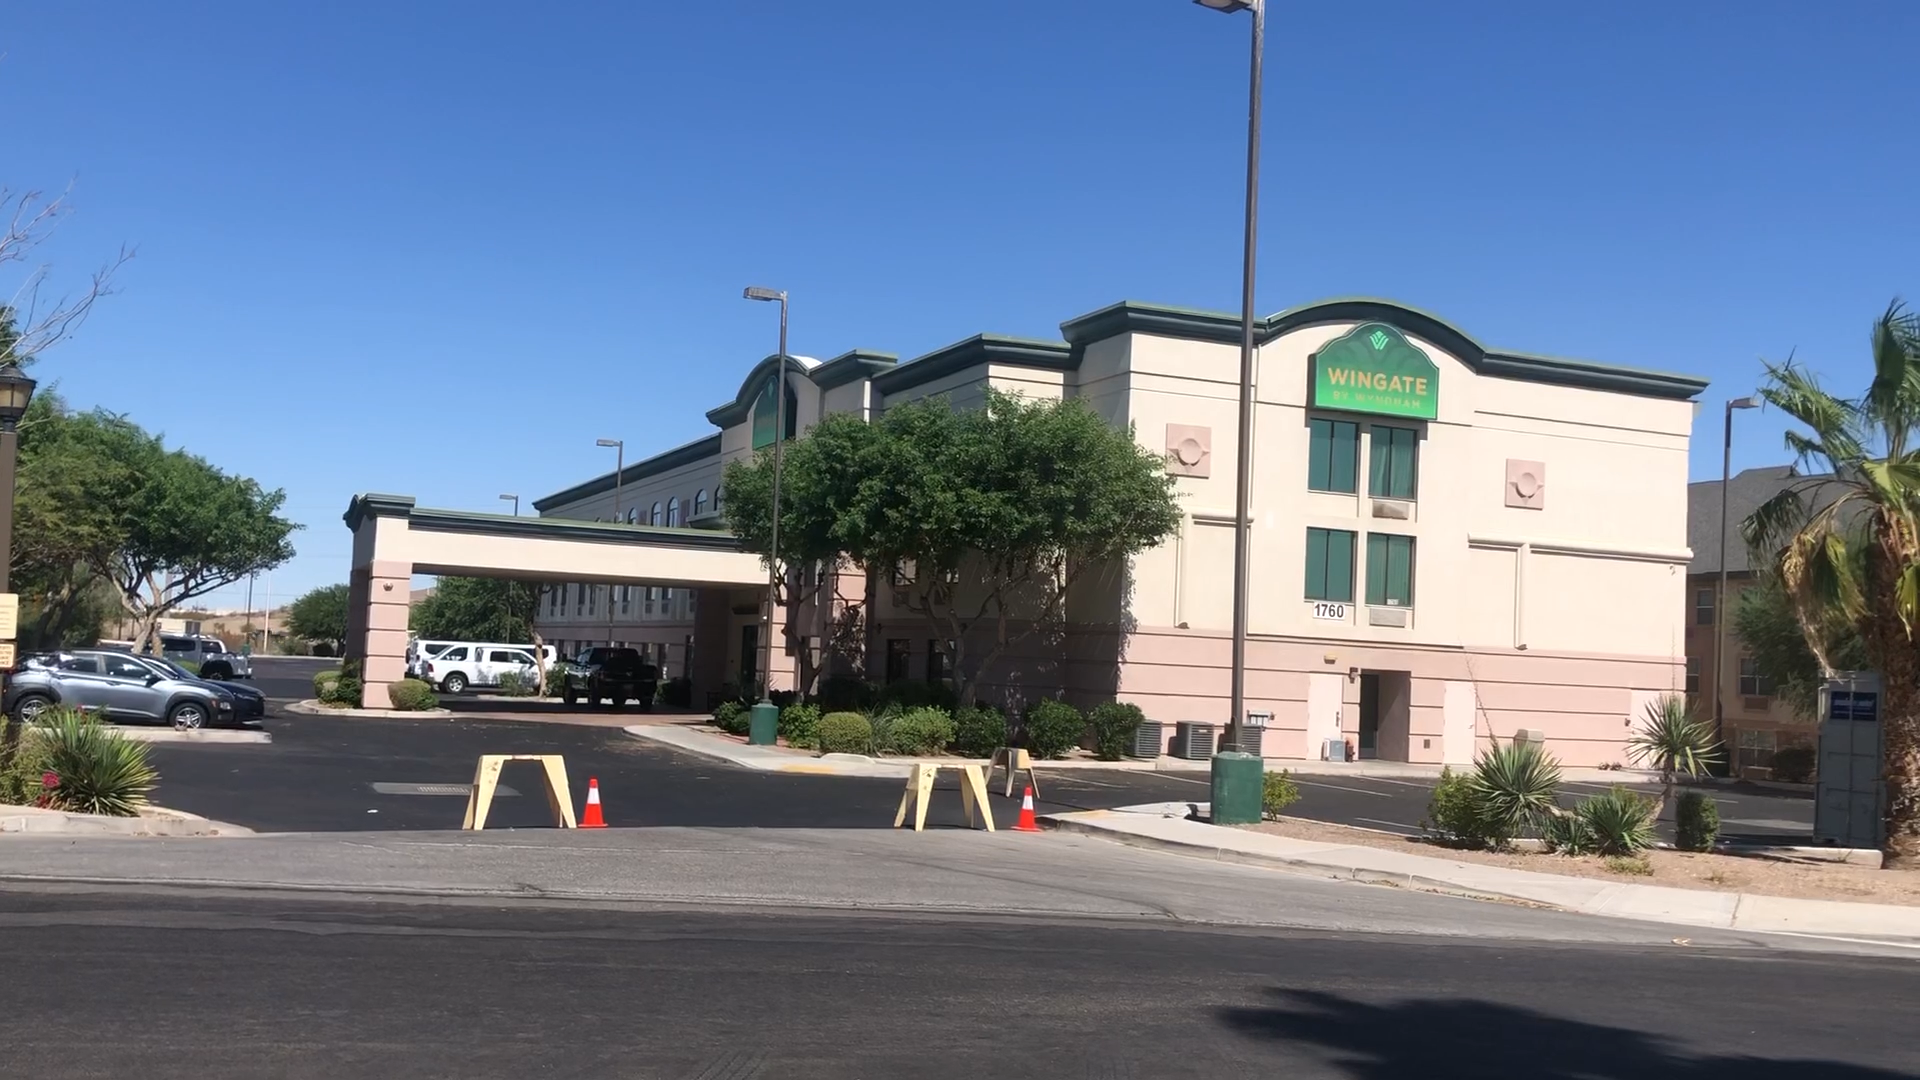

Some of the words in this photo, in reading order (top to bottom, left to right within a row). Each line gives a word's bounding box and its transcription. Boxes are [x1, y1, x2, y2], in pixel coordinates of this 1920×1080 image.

[1328, 367, 1427, 396] WINGATE
[1333, 390, 1349, 400] BY
[1355, 392, 1420, 408] WYNDHAM
[1314, 603, 1344, 618] 1760
